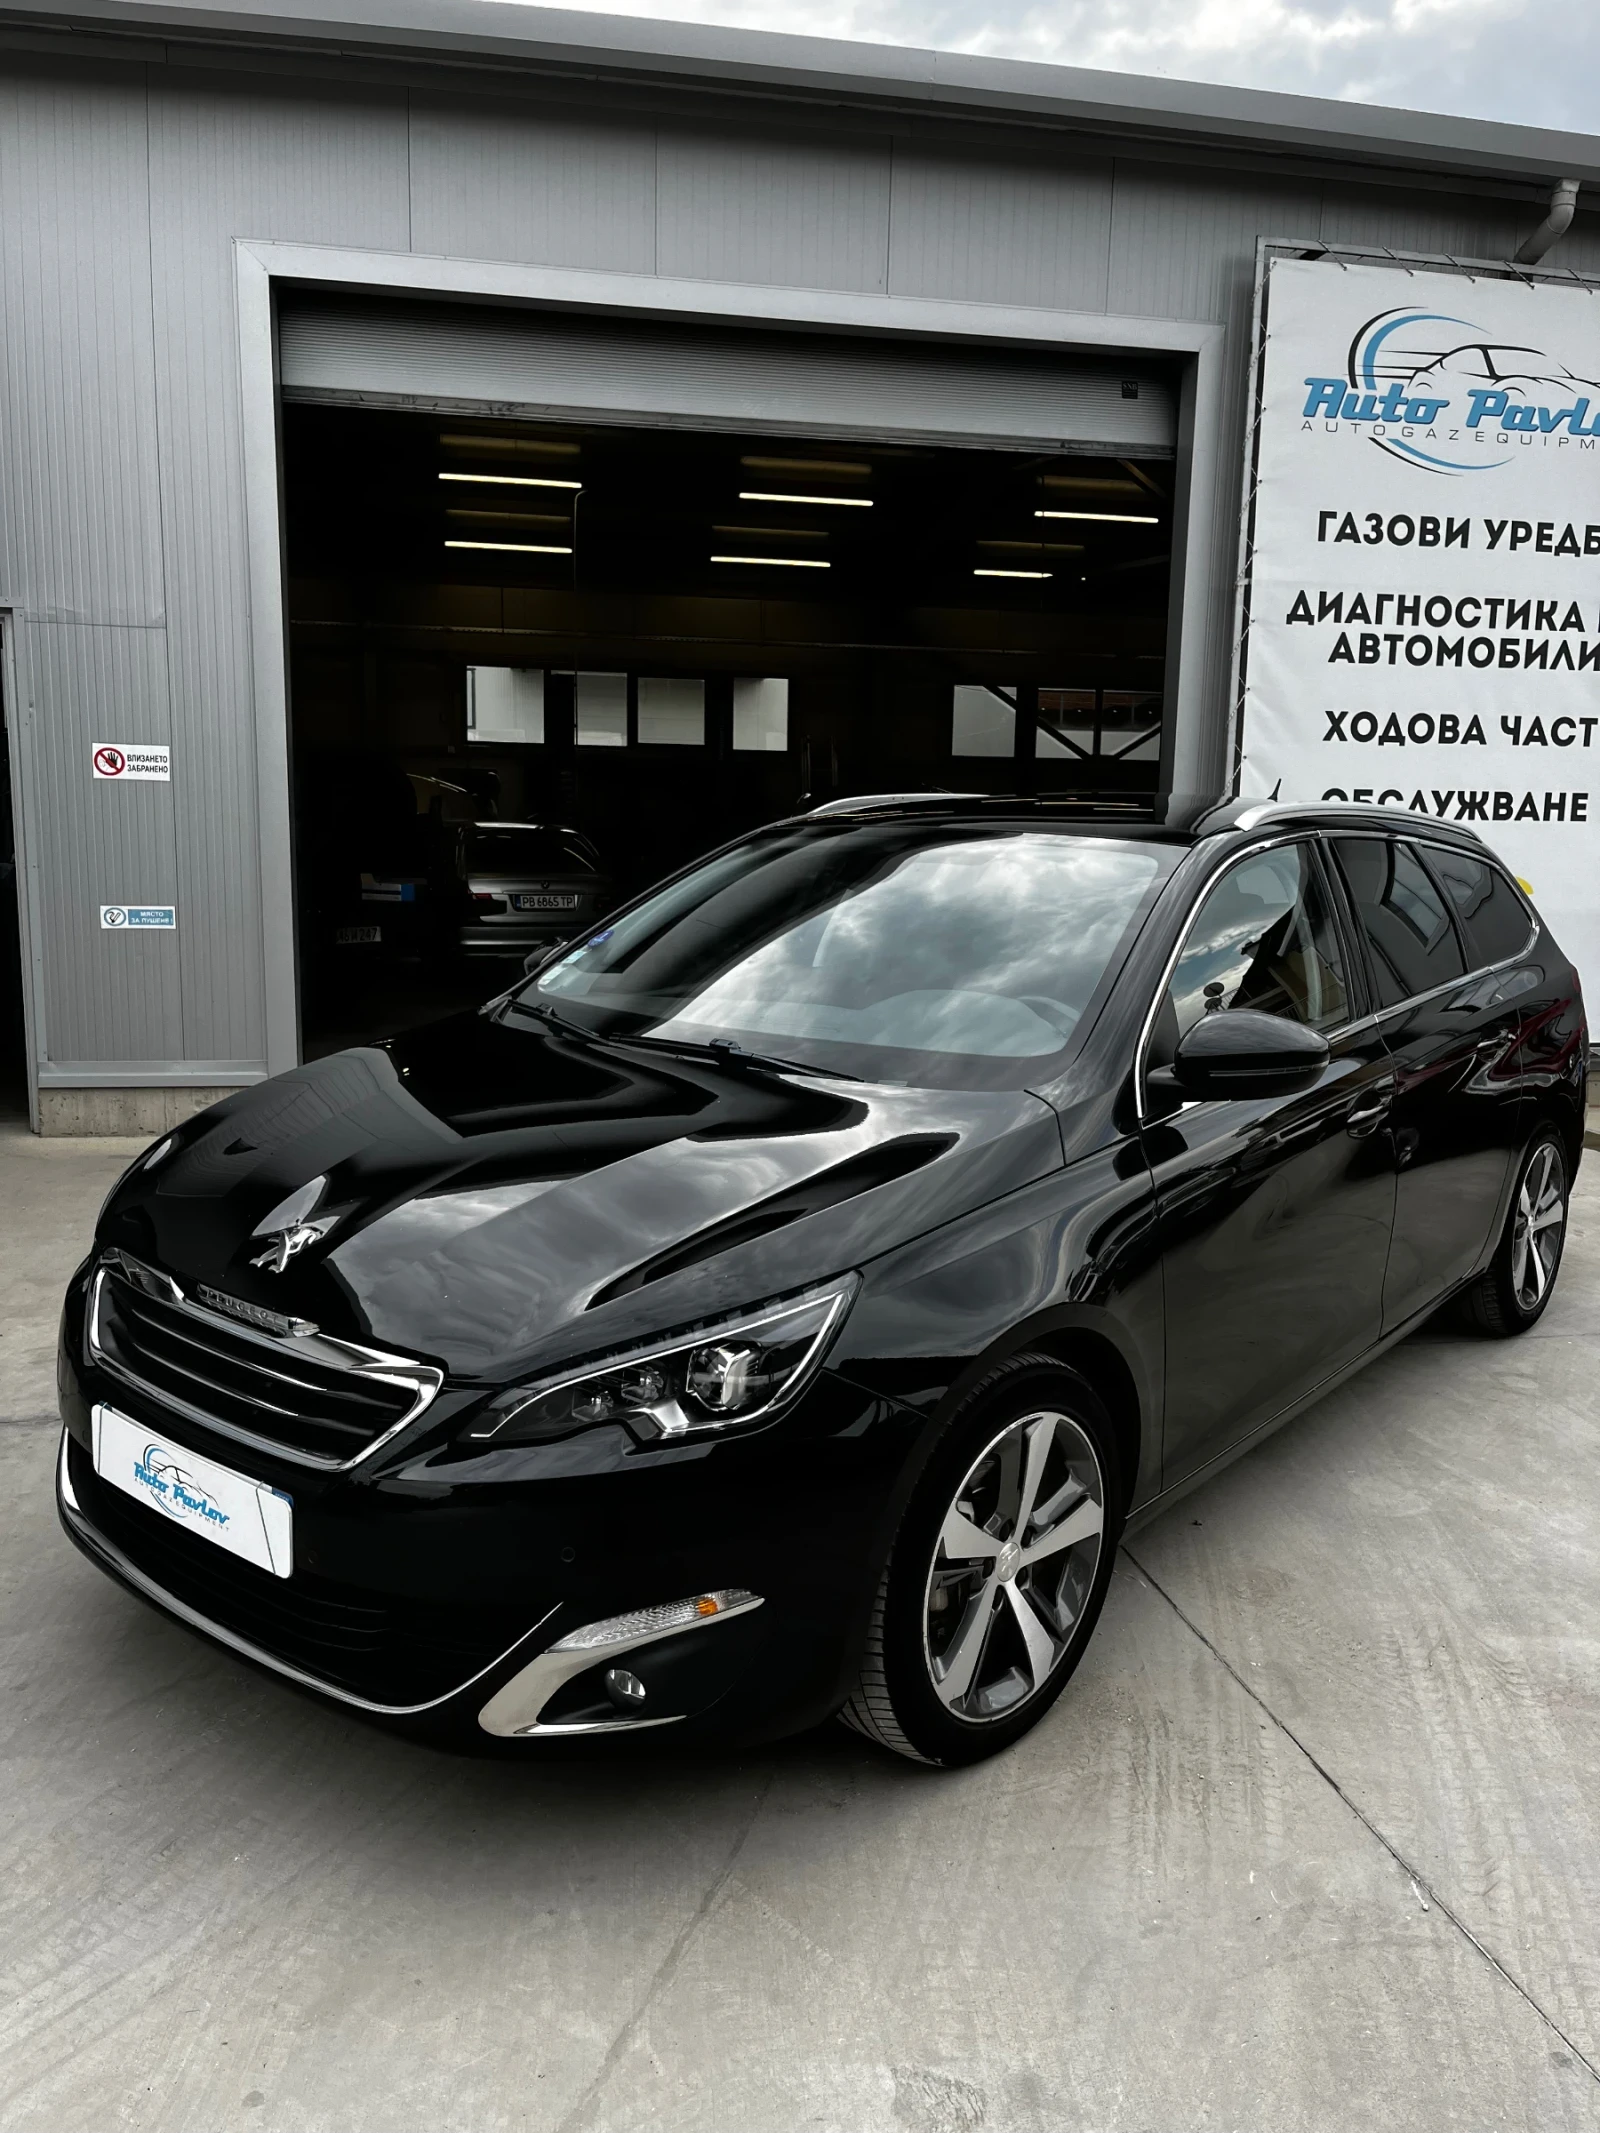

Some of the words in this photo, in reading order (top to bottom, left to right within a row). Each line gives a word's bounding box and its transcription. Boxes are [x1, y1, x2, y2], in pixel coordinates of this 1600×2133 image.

[1302, 377, 1450, 425] Auto
[1317, 510, 1471, 549] ГАЗОВИ
[1483, 519, 1600, 558] УРЕДБ
[1286, 589, 1585, 633] ДИАГНОСТИКА
[1327, 631, 1600, 672] АВТОМОБИЛИ
[1322, 710, 1487, 747] ХОДОВА
[1500, 715, 1599, 748] ЧАСТ
[127, 754, 168, 764] ВЛИЗАНЕТО
[127, 763, 169, 773] ЗАБРАНЕНО
[537, 896, 559, 907] 6865
[561, 896, 573, 907] TP
[206, 1289, 279, 1325] PEUGEOT
[134, 1461, 169, 1493] Auto
[173, 1483, 230, 1524] Pavlov
